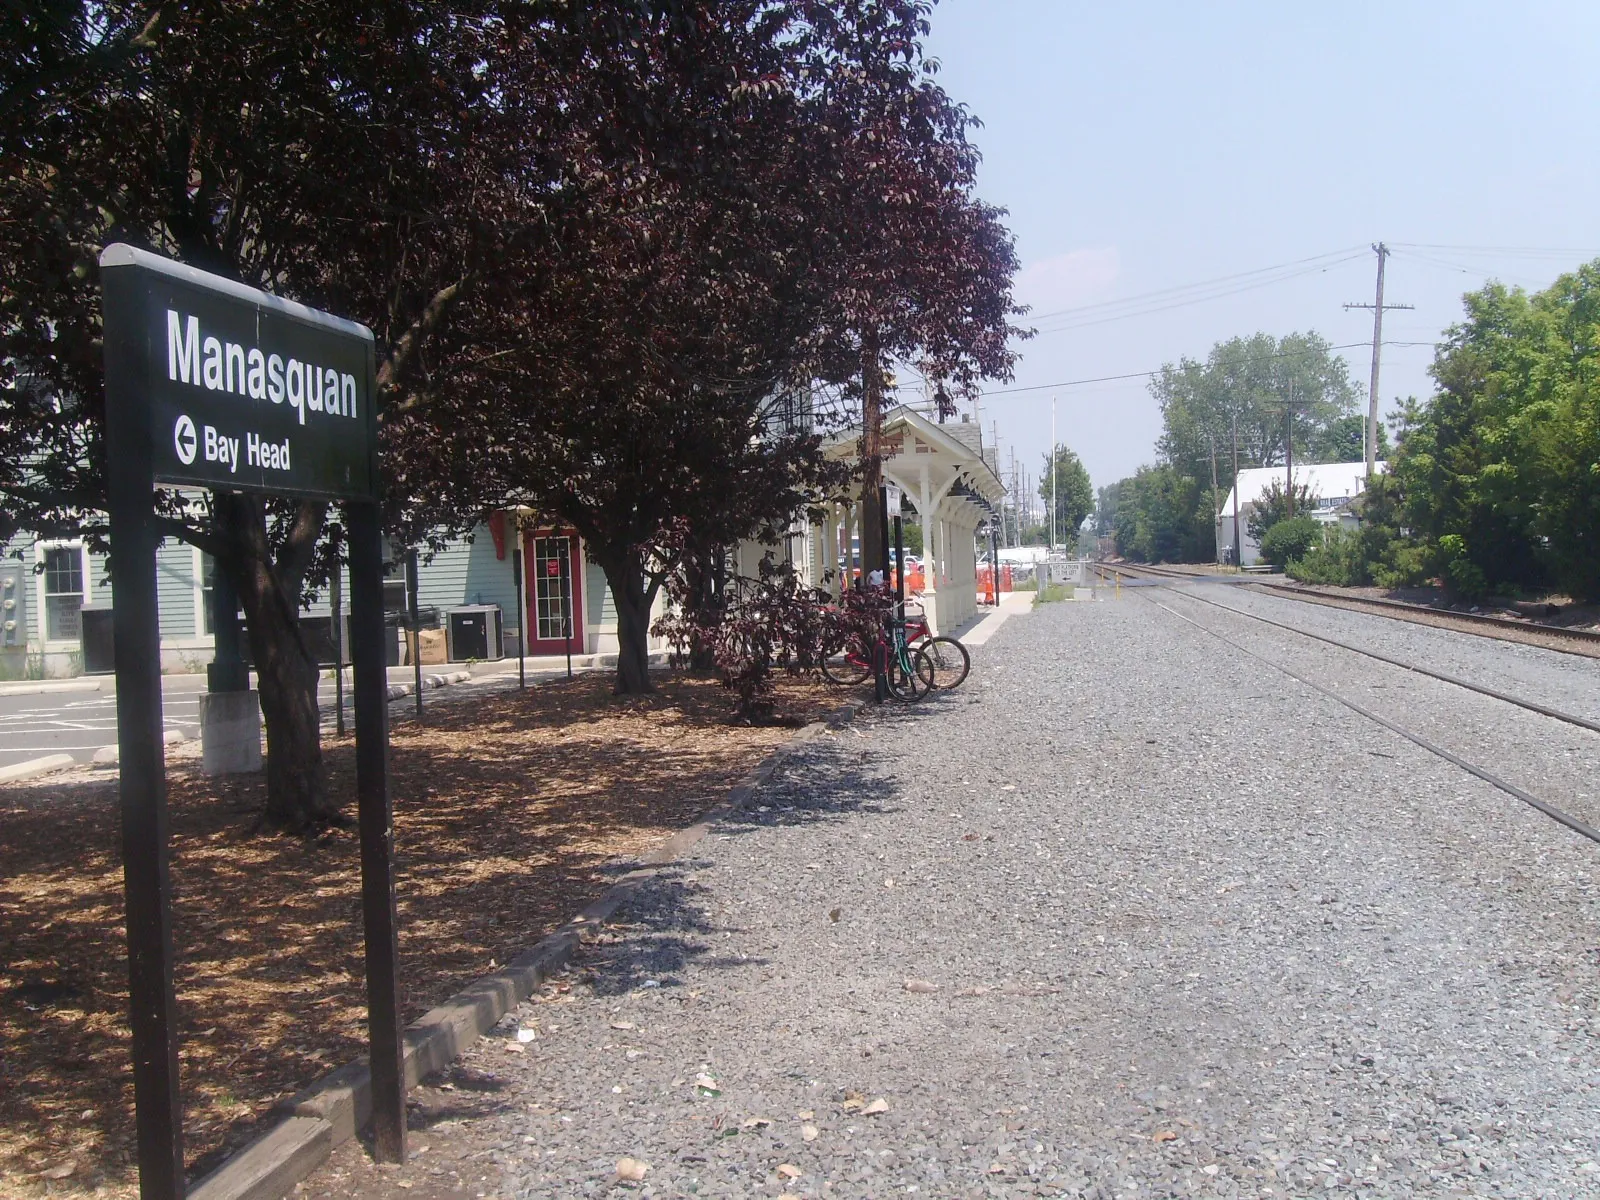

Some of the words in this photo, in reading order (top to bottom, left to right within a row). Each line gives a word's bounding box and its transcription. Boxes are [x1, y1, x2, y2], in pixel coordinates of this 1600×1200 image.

[167, 309, 357, 425] Manasquan
[204, 425, 239, 473] Bay
[247, 432, 291, 471] Head
